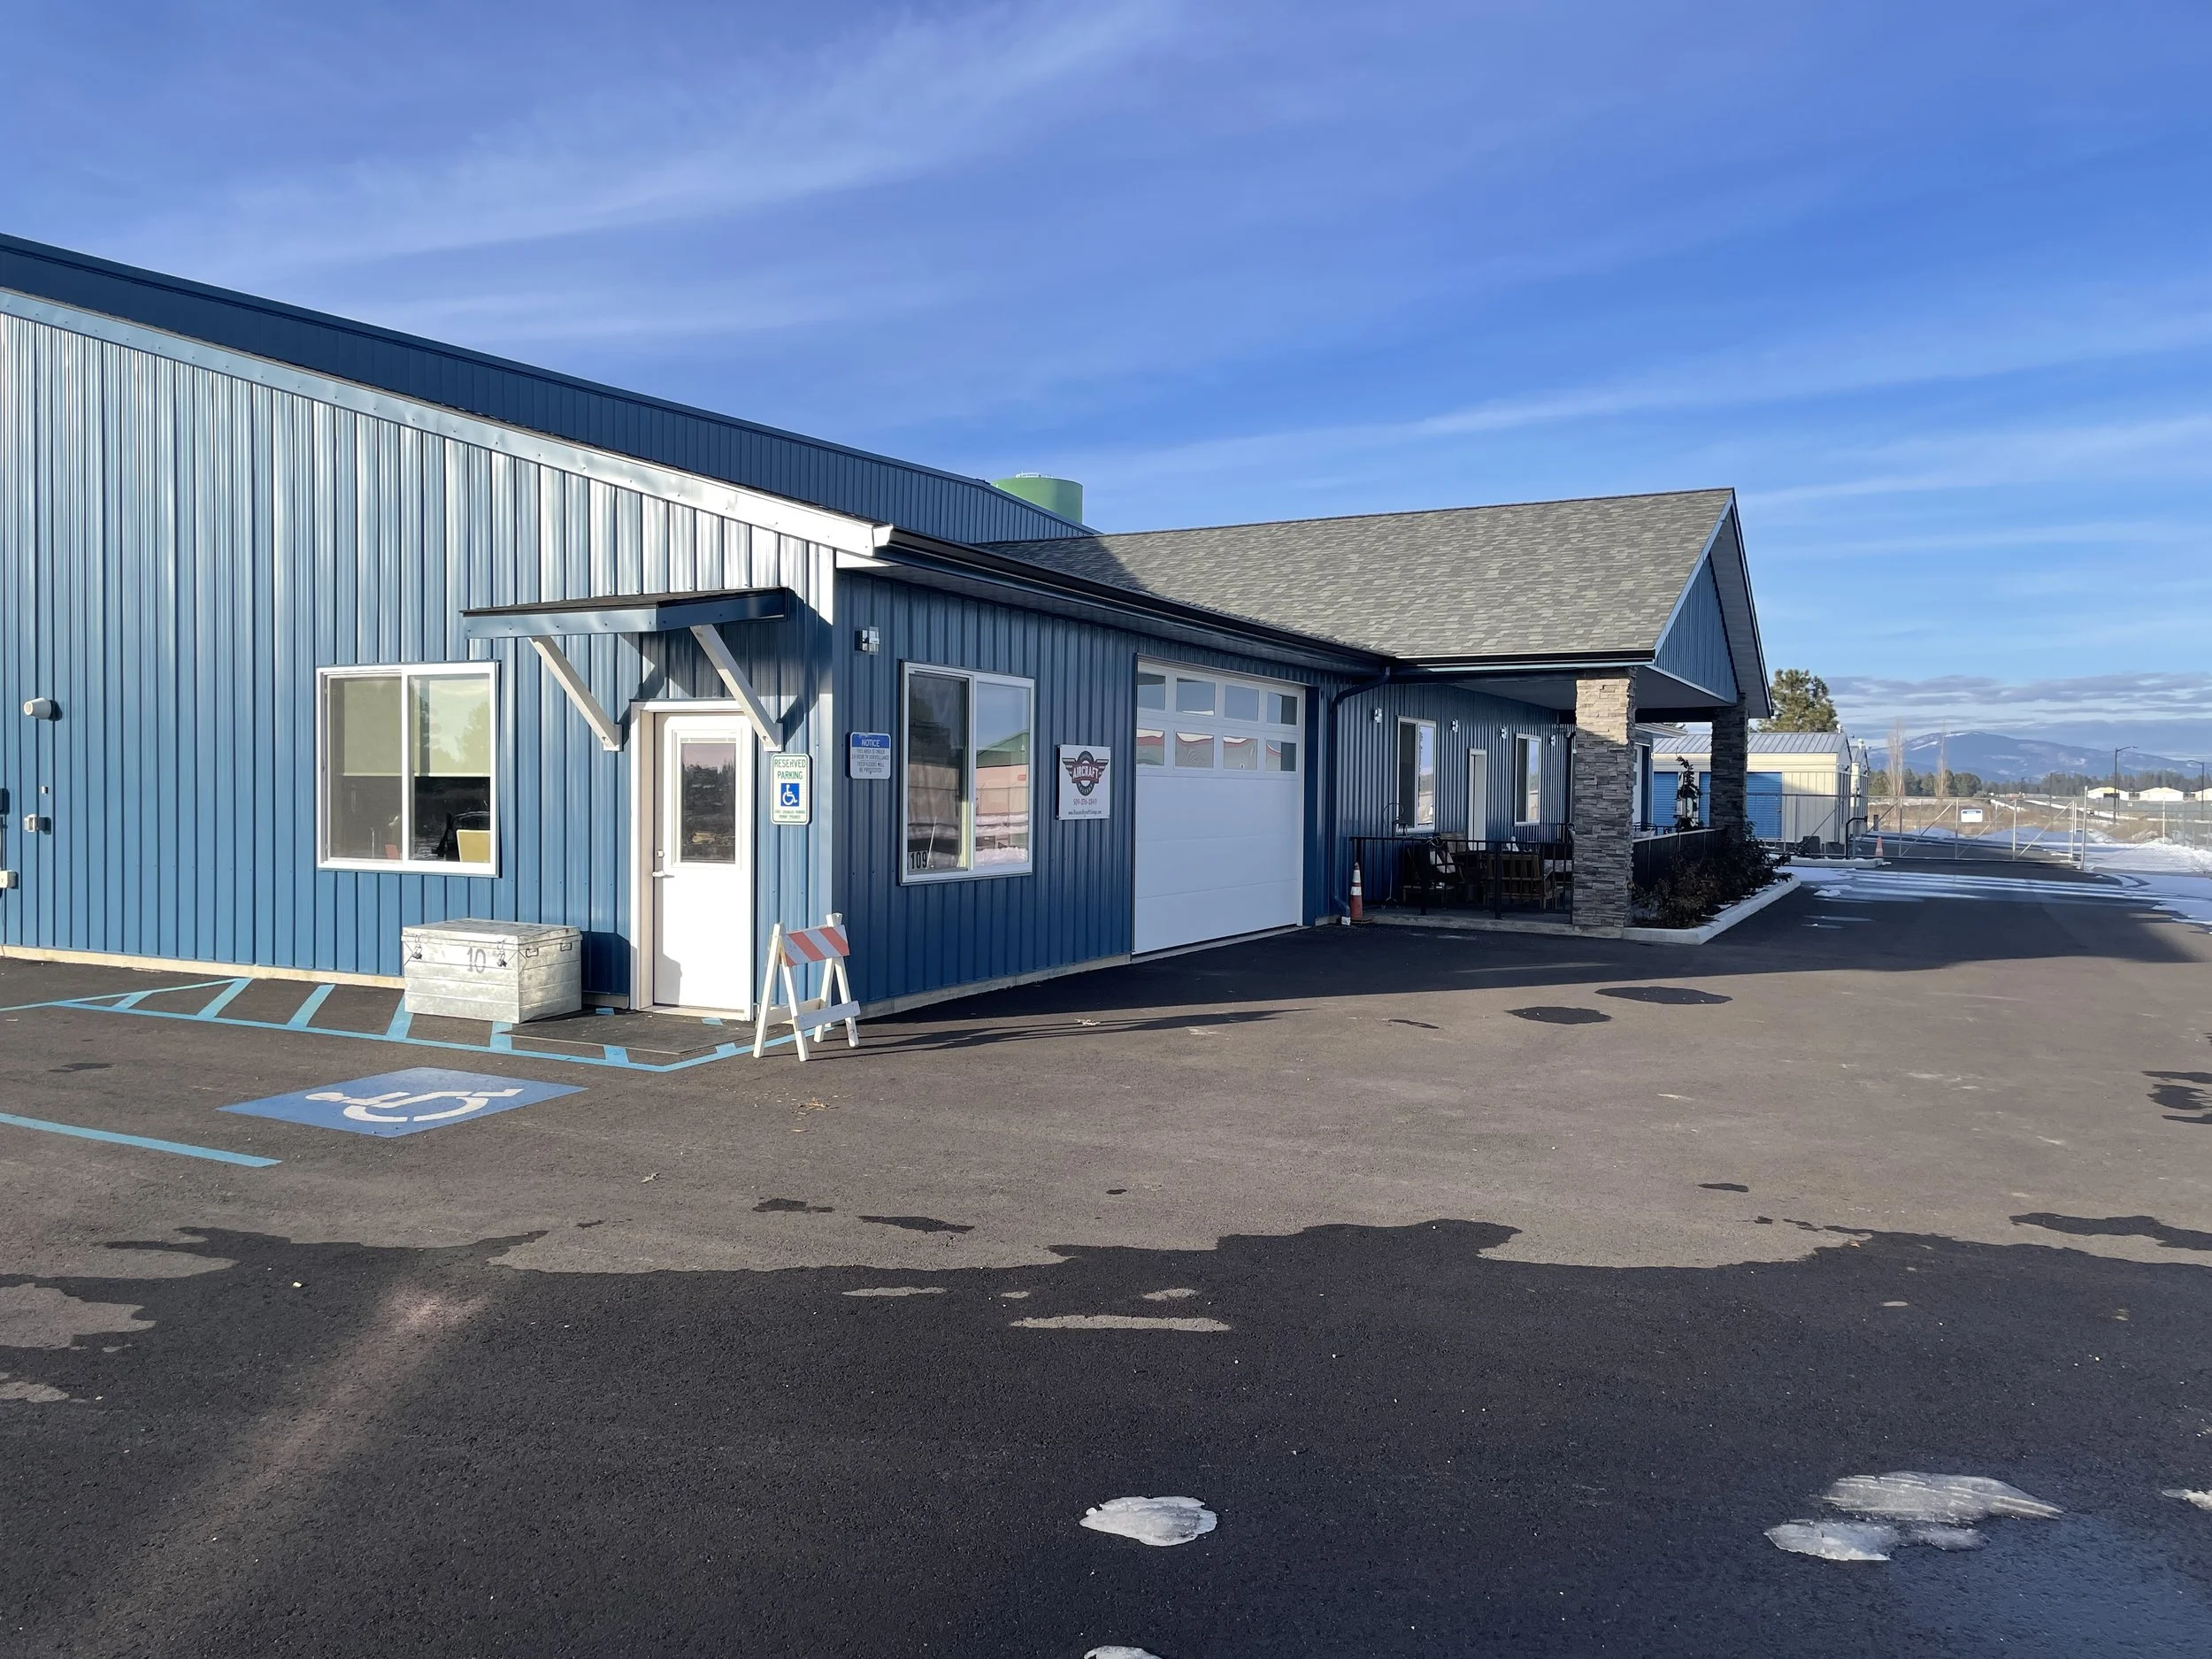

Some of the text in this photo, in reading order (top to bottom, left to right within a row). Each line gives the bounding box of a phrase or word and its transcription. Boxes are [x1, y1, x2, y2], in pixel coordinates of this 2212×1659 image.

[861, 738, 880, 748] NOTICE
[774, 758, 806, 768] RESERVED
[778, 771, 803, 780] PARKING
[1072, 765, 1099, 779] AIRCRAFT
[910, 851, 927, 870] 109
[466, 946, 487, 974] 10
